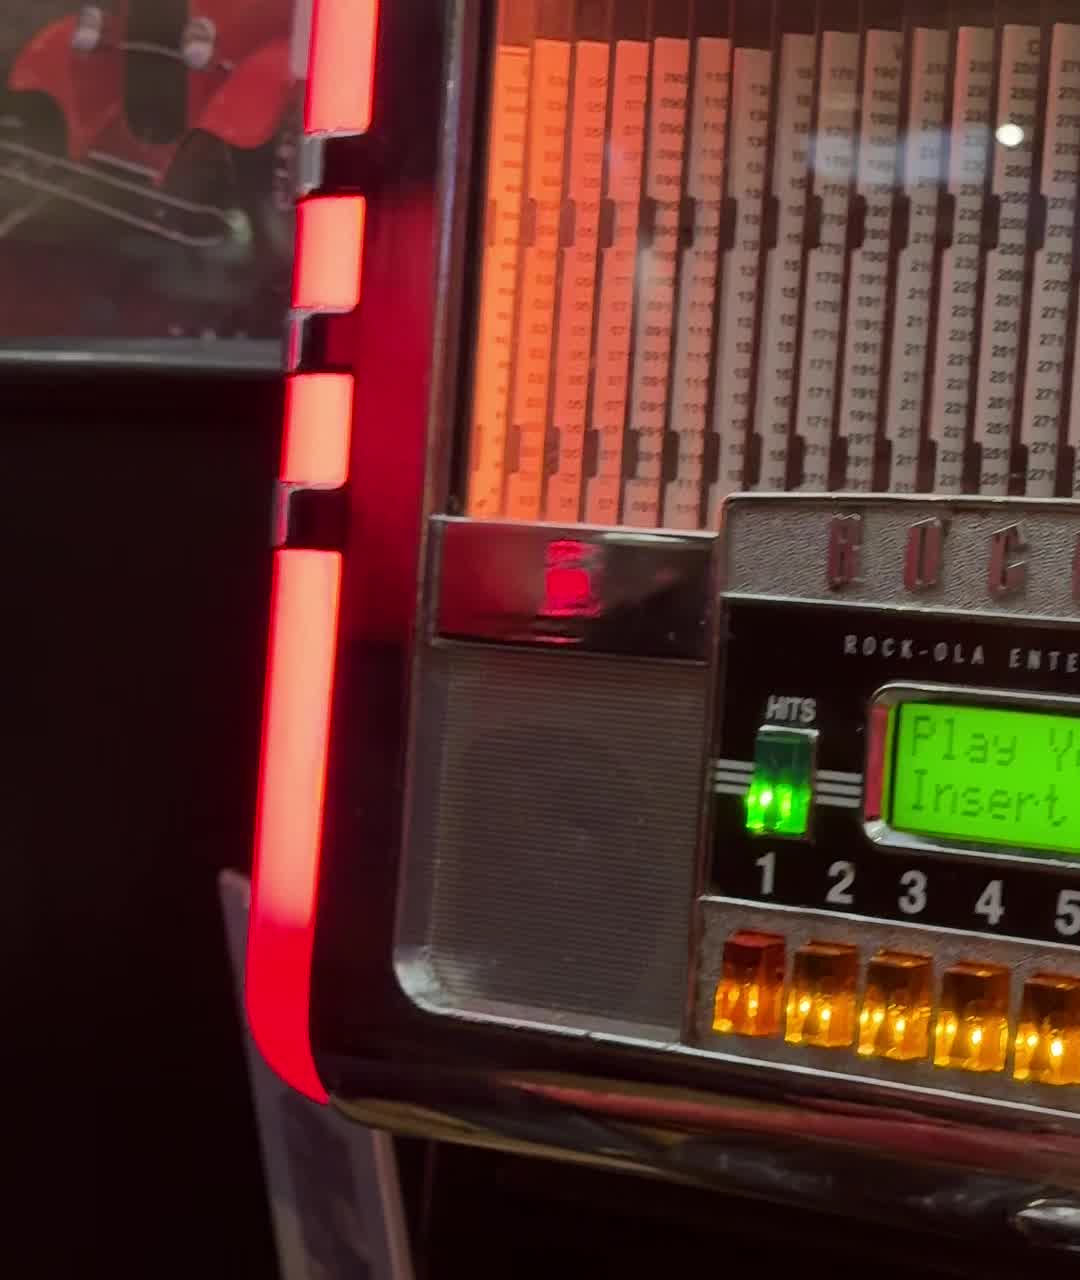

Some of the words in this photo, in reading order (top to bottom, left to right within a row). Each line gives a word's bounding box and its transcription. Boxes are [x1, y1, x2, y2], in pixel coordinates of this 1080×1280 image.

[843, 633, 985, 666] ROCK-OLA
[766, 694, 817, 723] HITS
[910, 713, 1018, 768] Play
[909, 768, 1068, 829] Insert
[753, 851, 776, 896] 1
[824, 859, 857, 905] 2
[898, 869, 929, 915] 3
[974, 879, 1005, 926] 4
